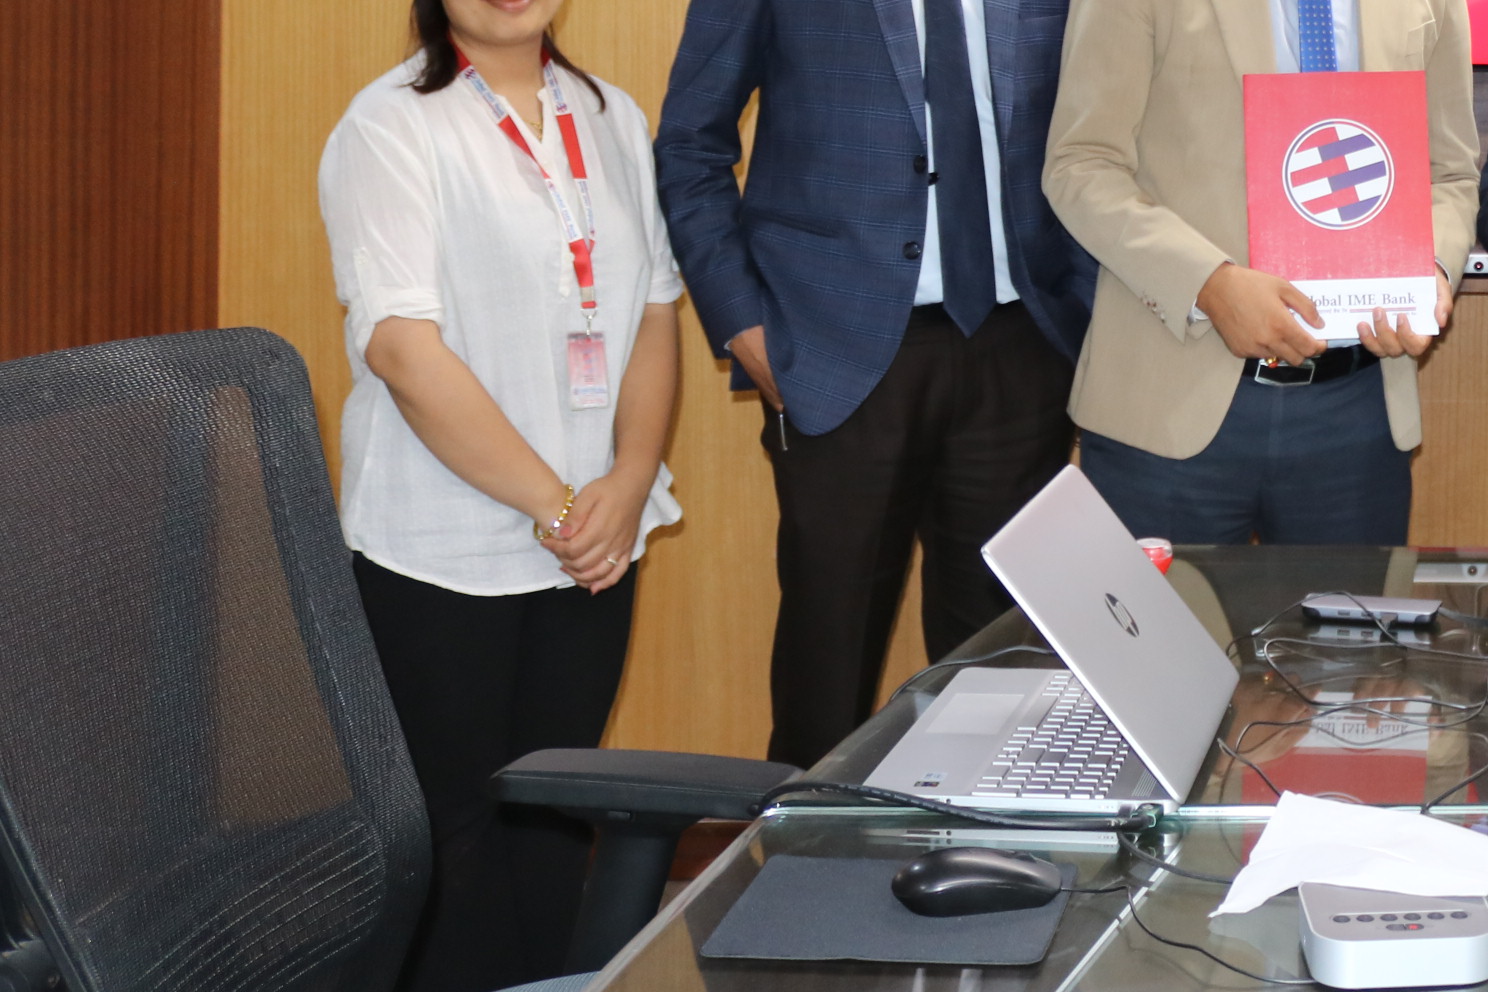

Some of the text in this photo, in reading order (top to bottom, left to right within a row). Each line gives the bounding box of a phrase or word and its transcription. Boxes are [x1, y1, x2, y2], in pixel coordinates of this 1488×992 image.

[1309, 292, 1416, 307] lobal IME Bank
